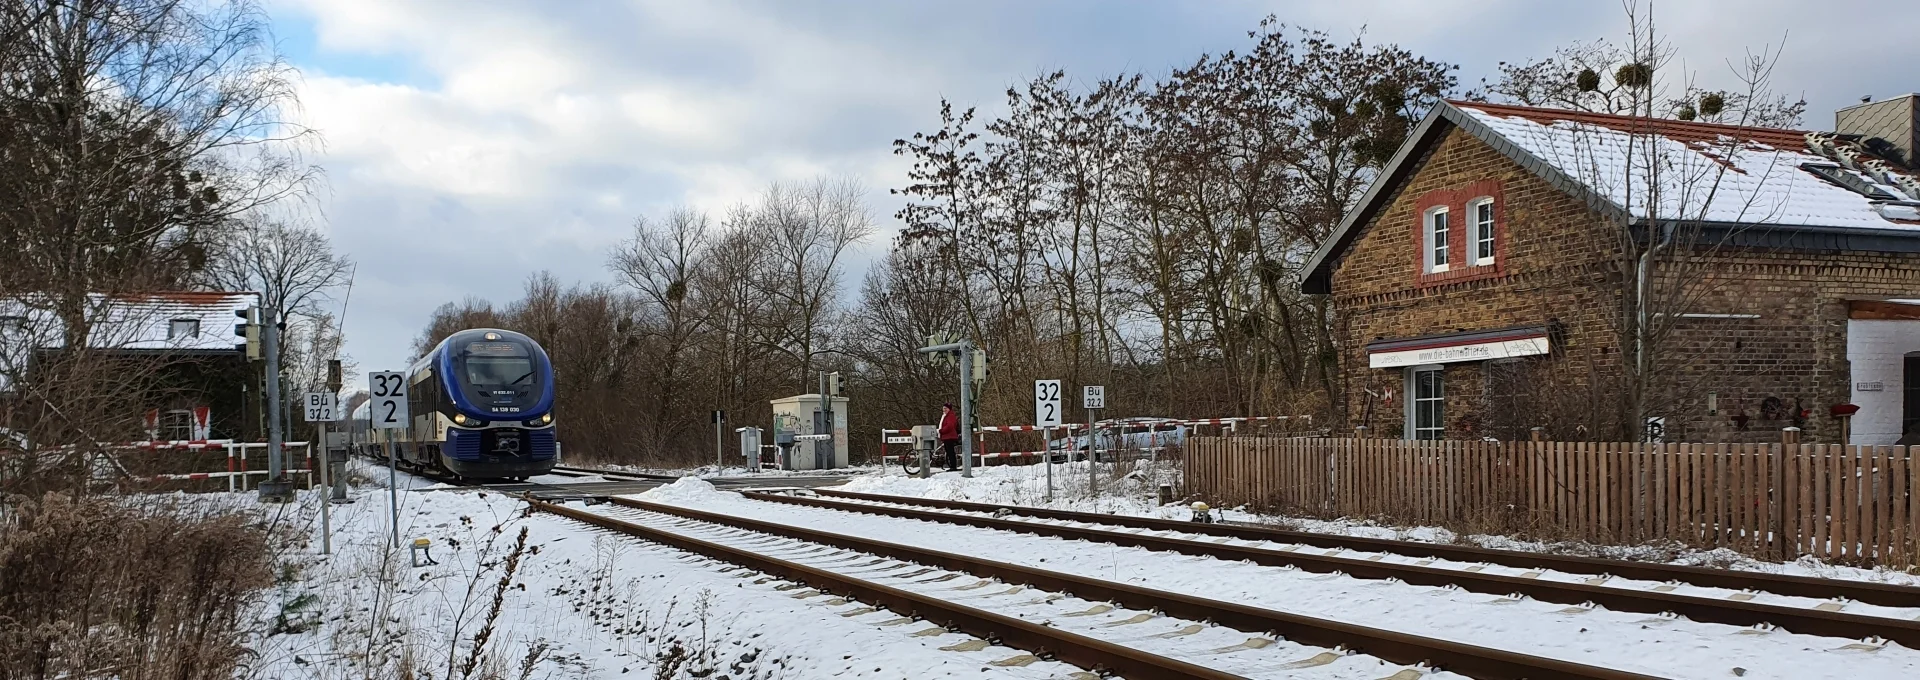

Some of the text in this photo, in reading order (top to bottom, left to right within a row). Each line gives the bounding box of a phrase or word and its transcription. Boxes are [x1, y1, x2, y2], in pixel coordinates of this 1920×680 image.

[374, 374, 404, 397] 32
[1038, 383, 1059, 401] 32
[1088, 387, 1100, 396] Bü
[311, 394, 328, 406] Bü
[1087, 398, 1101, 407] 32.2
[309, 408, 330, 420] 32.2
[383, 400, 397, 422] 2
[1044, 403, 1055, 421] 2
